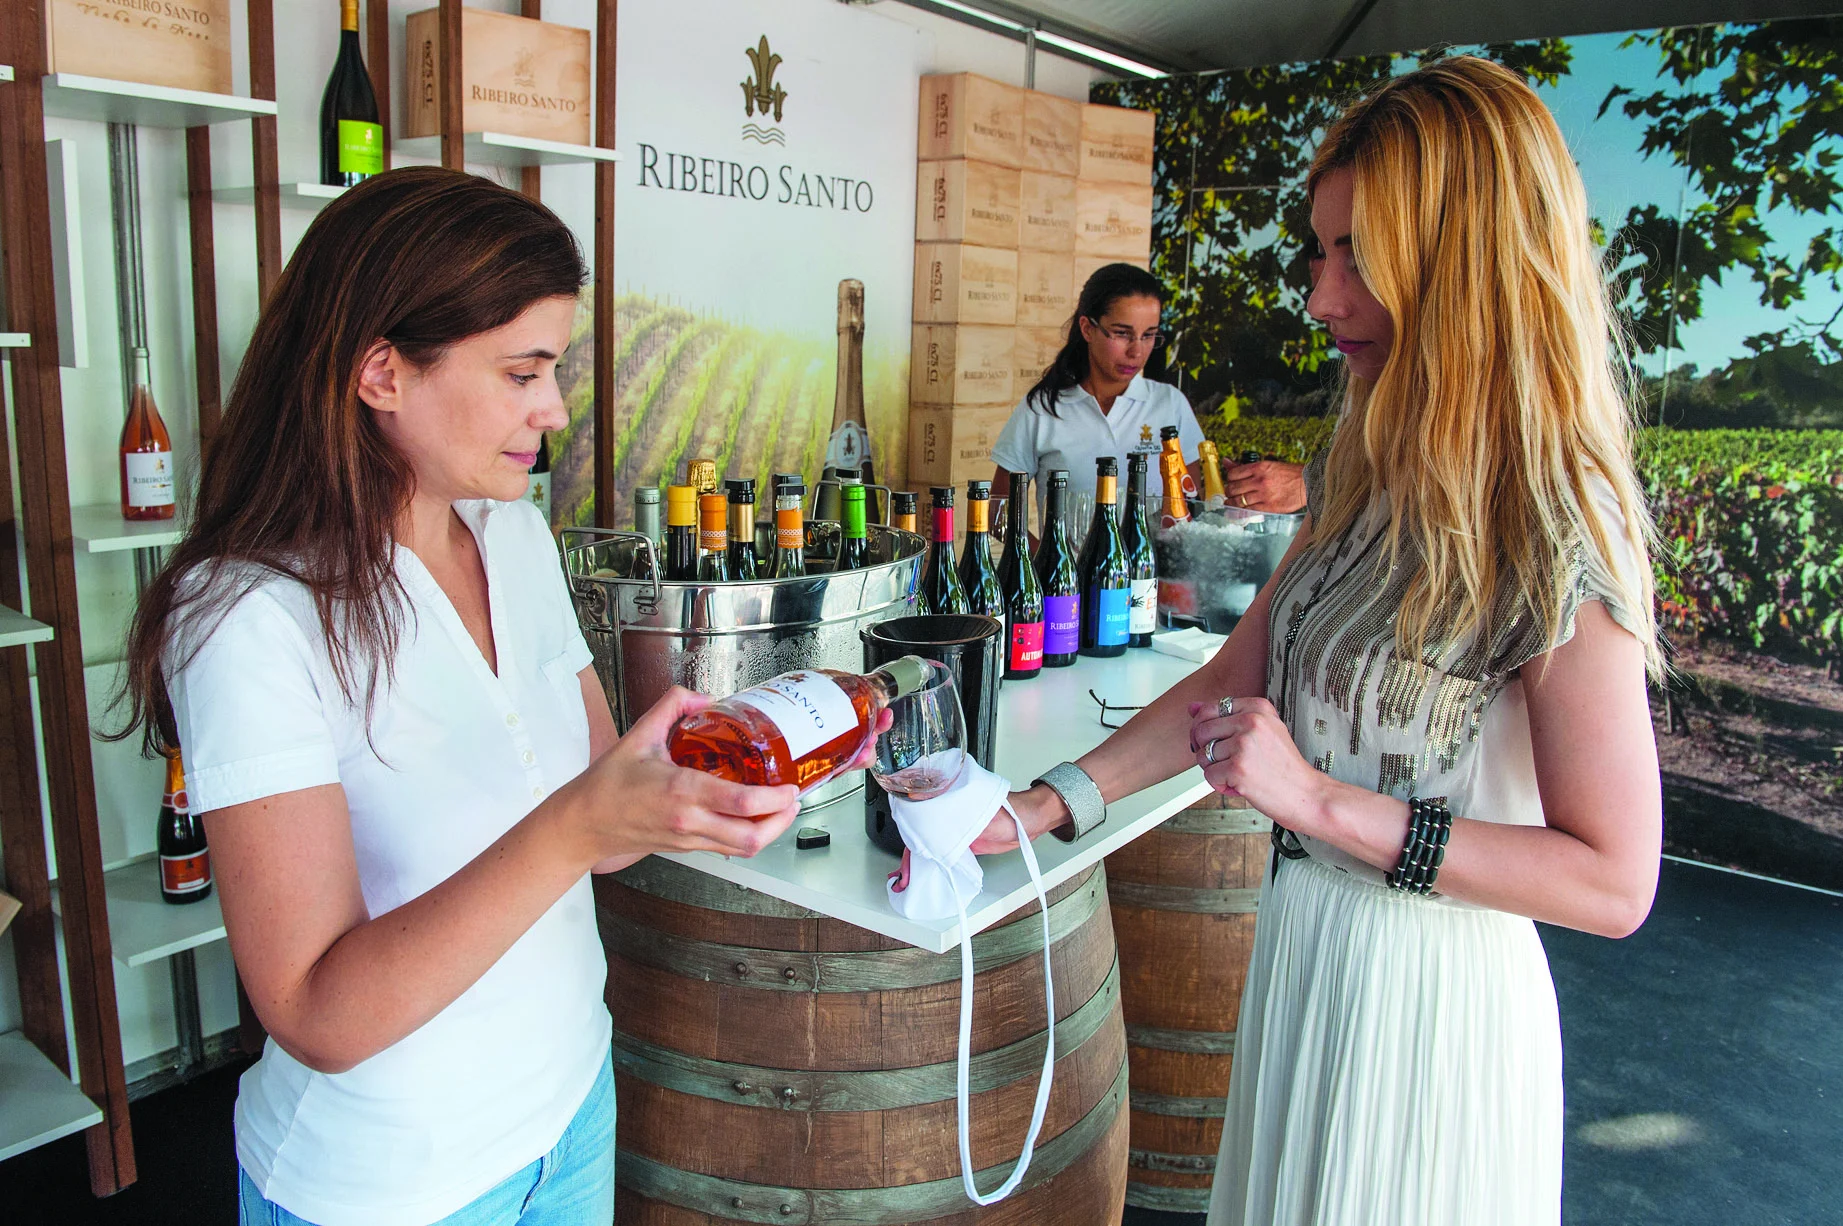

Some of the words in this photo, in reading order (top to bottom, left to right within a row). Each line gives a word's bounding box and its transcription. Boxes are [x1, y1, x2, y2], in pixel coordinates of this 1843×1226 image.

[165, 3, 210, 25] SANTO
[472, 85, 528, 106] RIBEIRO
[531, 93, 577, 113] SANTO
[637, 142, 769, 201] RIBEIRO
[778, 165, 874, 213] SANTO
[1050, 620, 1076, 630] RIBEIRO
[784, 685, 825, 729] SANTO
